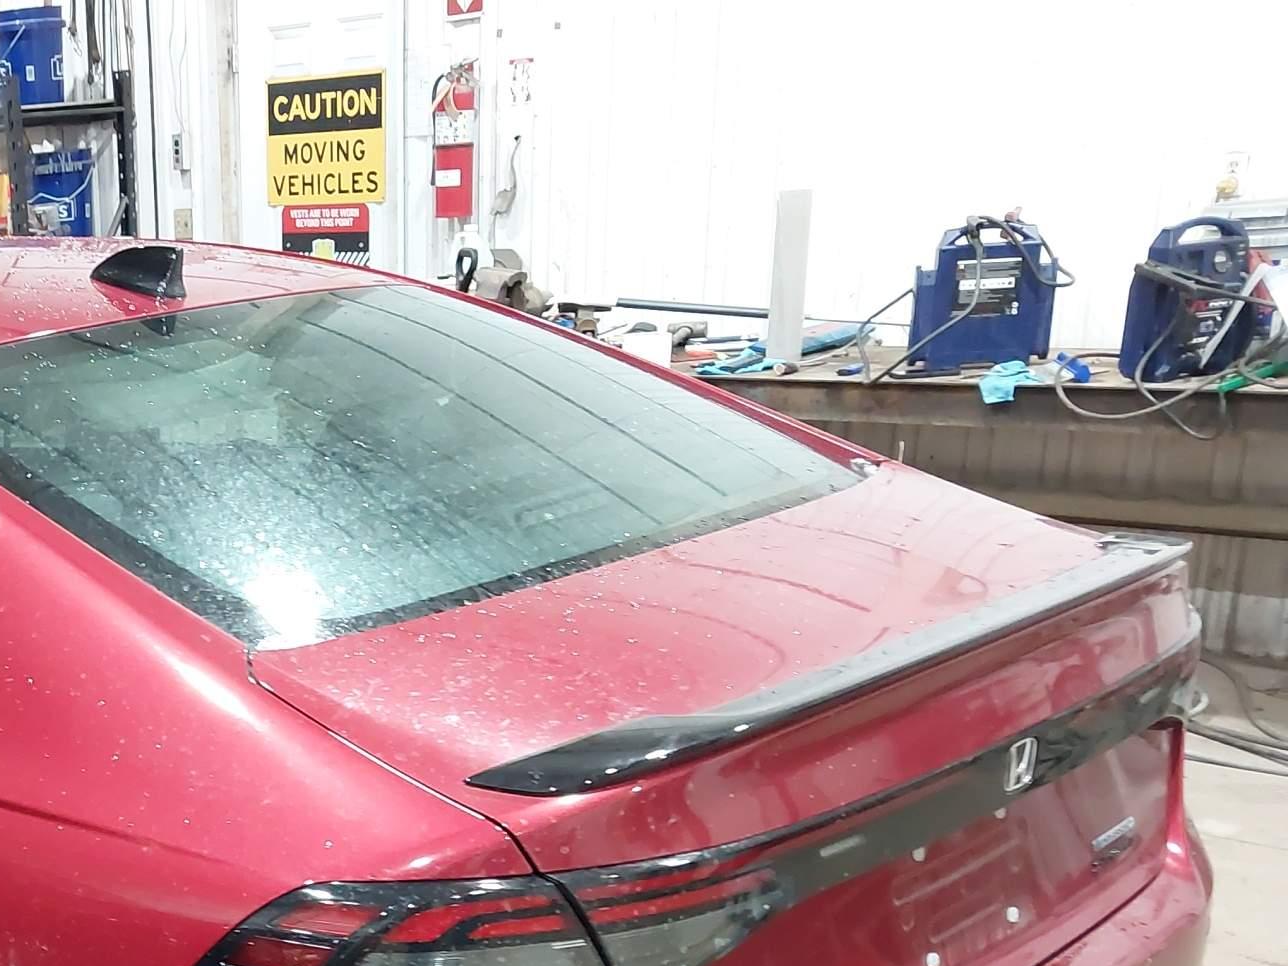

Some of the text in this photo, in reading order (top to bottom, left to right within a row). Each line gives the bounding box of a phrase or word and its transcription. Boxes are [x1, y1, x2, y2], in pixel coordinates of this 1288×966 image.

[273, 87, 377, 122] CAUTION
[284, 139, 366, 165] MOVING
[273, 171, 379, 197] VEHICLES
[309, 208, 321, 218] ARE
[321, 207, 331, 218] TO
[330, 207, 340, 217] BE
[319, 218, 334, 227] THIS
[334, 217, 354, 227] POINT
